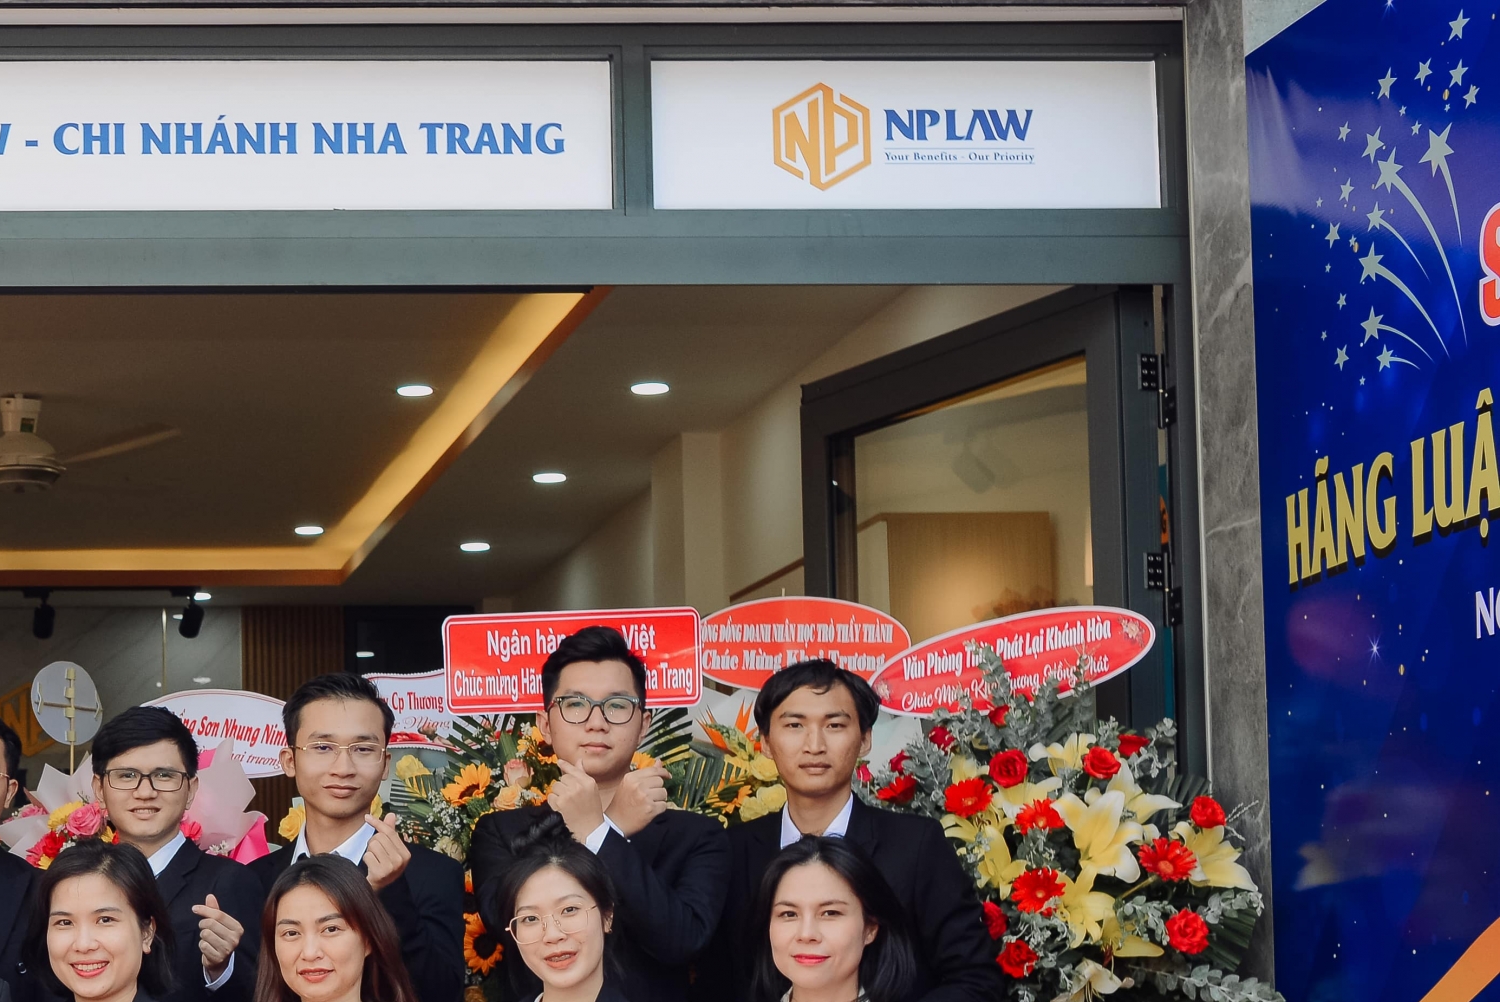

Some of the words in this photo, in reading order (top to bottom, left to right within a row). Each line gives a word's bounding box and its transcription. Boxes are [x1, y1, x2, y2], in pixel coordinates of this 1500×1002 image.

[53, 122, 125, 156] CHI
[141, 114, 298, 155] NHÁNH
[312, 122, 407, 155] NHA
[419, 122, 566, 155] TRANG
[884, 152, 910, 162] Your
[913, 151, 958, 162] Benefits
[968, 152, 990, 162] Our
[993, 152, 1035, 164] Priority
[1285, 451, 1397, 585] HÃNG
[743, 623, 772, 643] DOANH
[772, 618, 797, 643] NHÂN
[862, 617, 894, 644] THÀNH
[1475, 587, 1500, 640] N
[486, 628, 531, 663] Ngân
[621, 623, 657, 657] Việt
[702, 648, 740, 670] Chúc
[742, 647, 783, 675] Mừng
[902, 655, 926, 681] Văn
[927, 648, 963, 678] Phòng
[1025, 631, 1044, 660] Lại
[1045, 620, 1085, 652] Khánh
[1086, 614, 1112, 643] Hòa
[454, 668, 483, 697] Chúc
[486, 668, 519, 703] mừng
[521, 667, 544, 695] Hãn
[660, 661, 693, 696] Trang
[220, 717, 261, 748] Nhung
